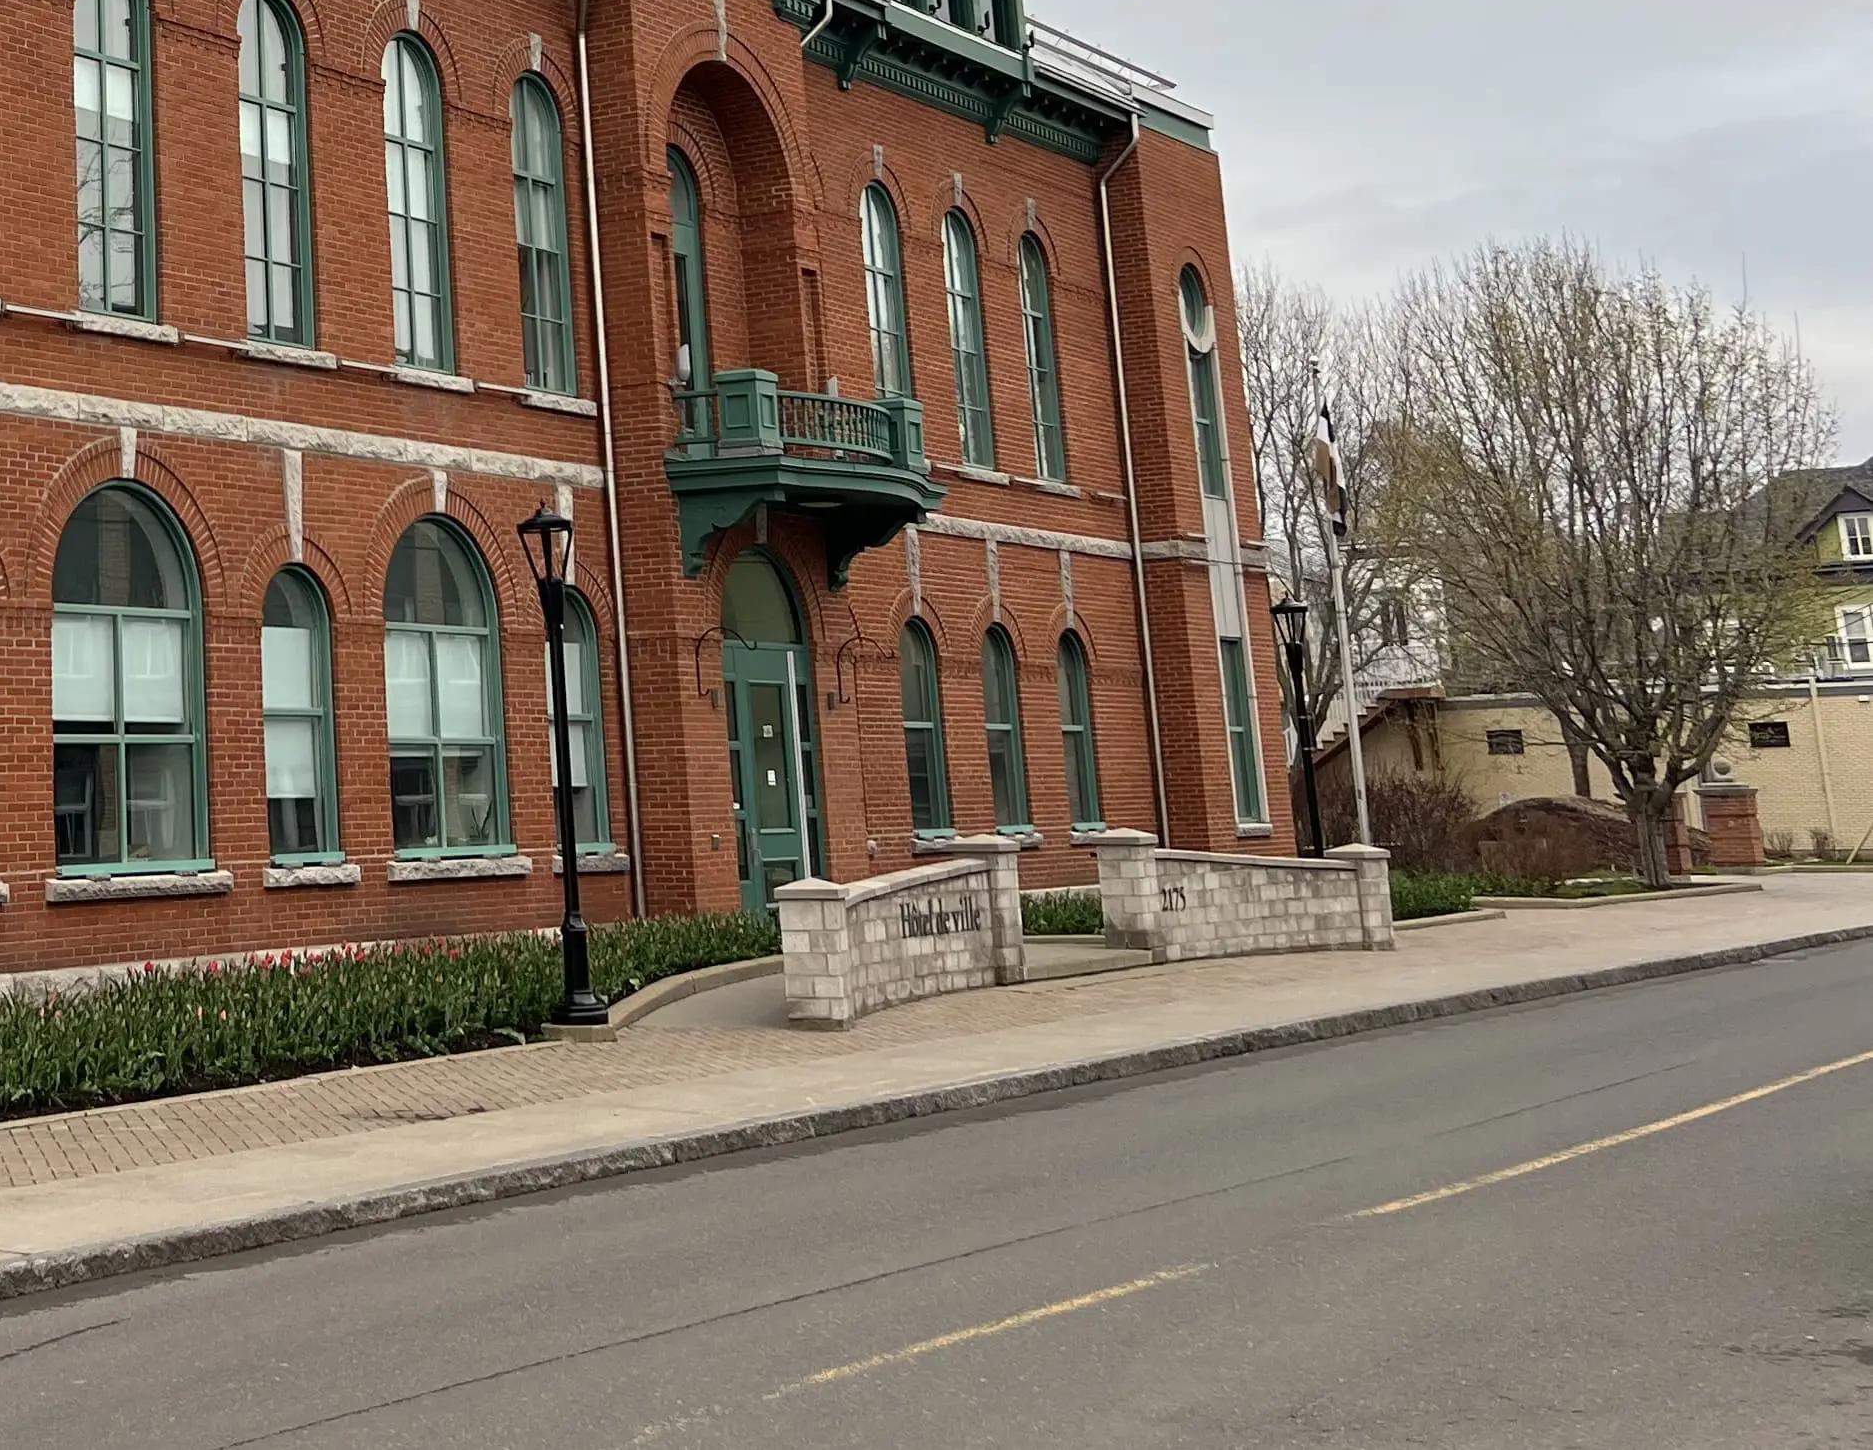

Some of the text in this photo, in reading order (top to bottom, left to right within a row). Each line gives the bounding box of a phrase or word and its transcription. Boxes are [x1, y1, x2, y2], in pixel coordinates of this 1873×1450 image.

[1161, 886, 1186, 912] 2175
[899, 895, 981, 938] Hôtel de ville
